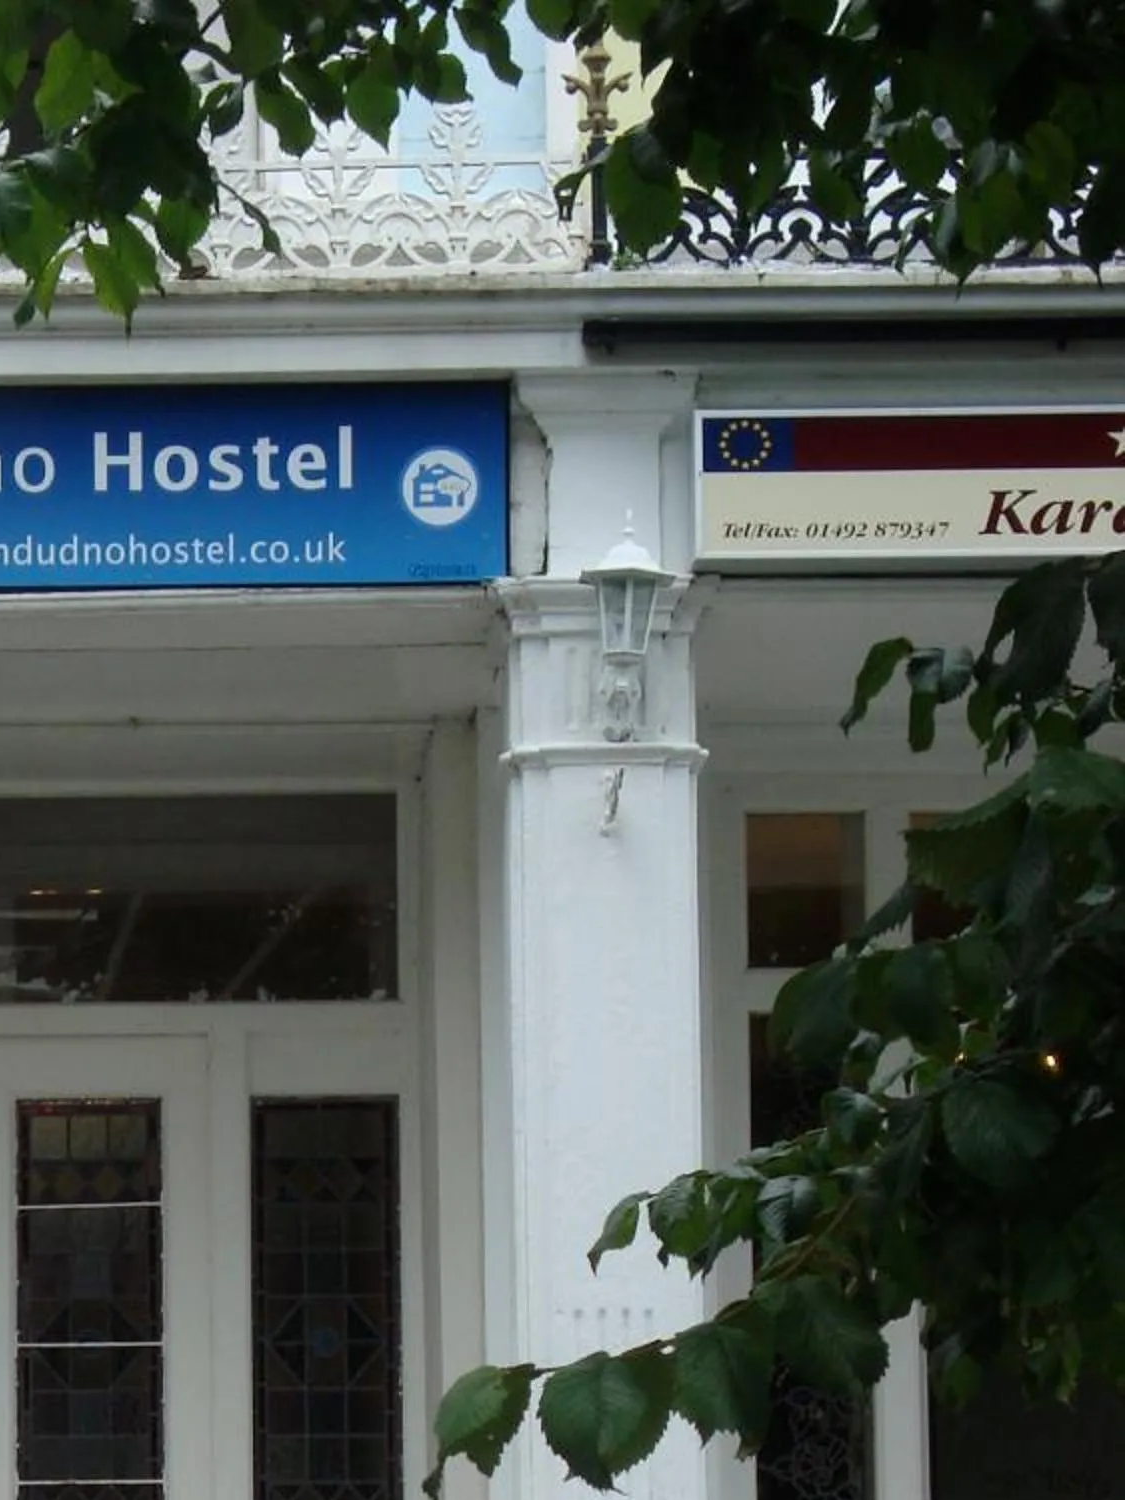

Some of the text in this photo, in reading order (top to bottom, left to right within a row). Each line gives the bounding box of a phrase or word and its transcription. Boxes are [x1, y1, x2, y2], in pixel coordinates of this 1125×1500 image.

[94, 426, 352, 492] Hostel
[724, 522, 950, 539] Tel/Fax: 01492 879347
[979, 490, 1125, 535] Kar
